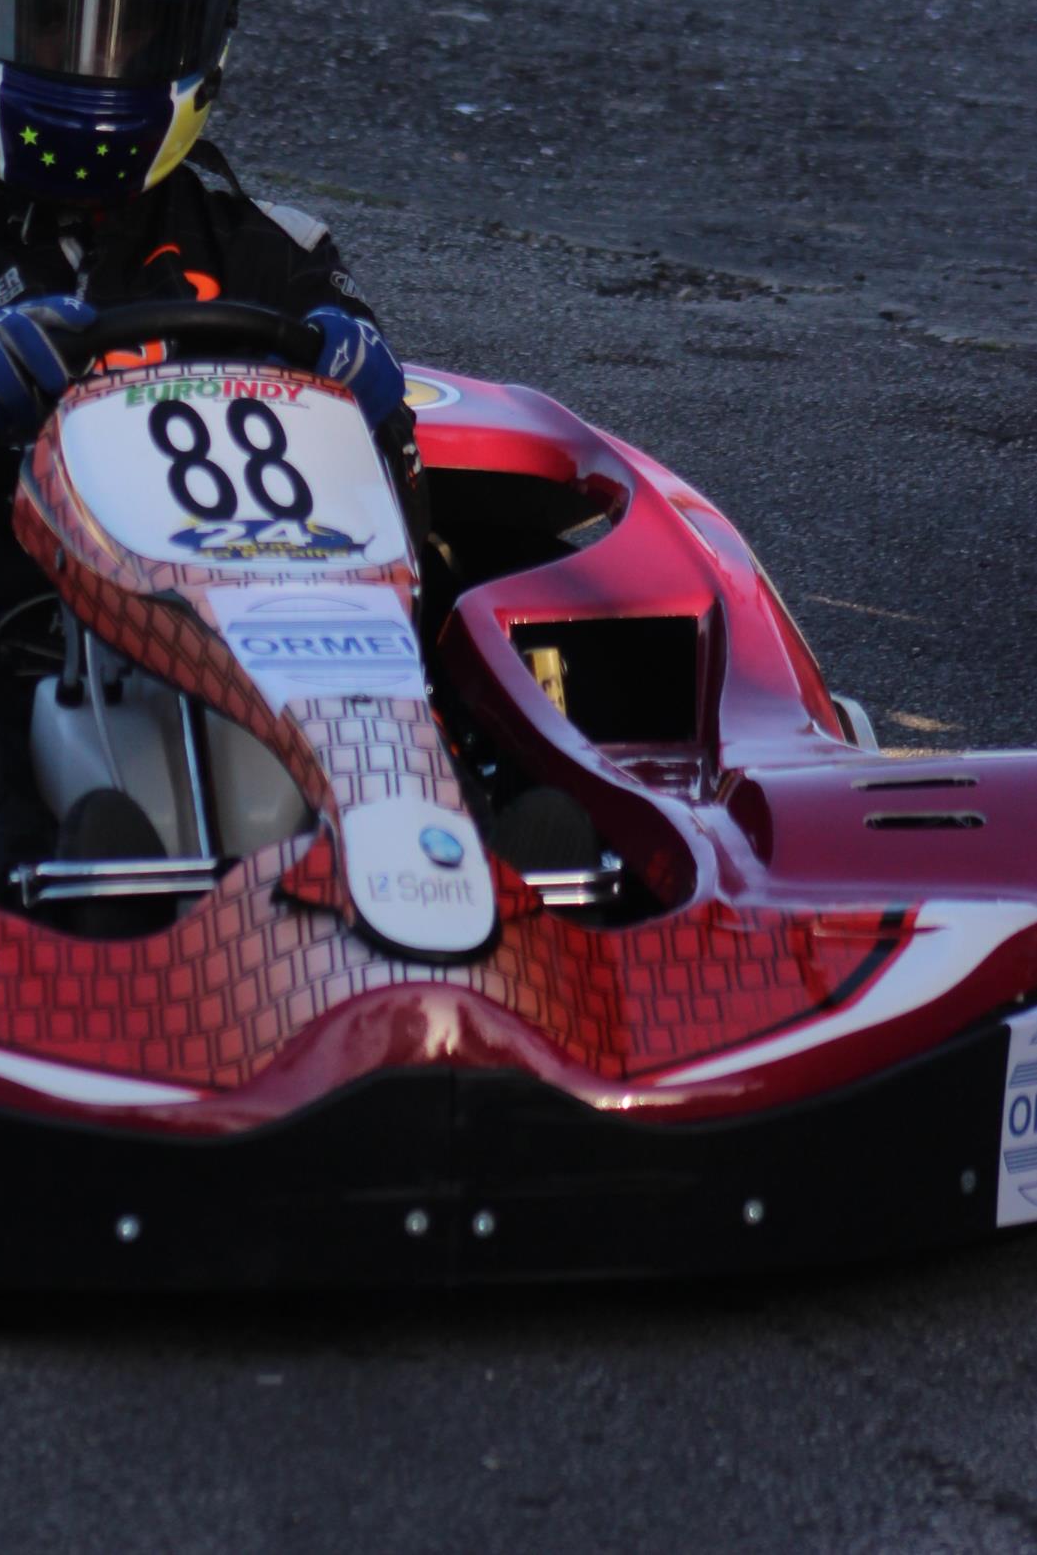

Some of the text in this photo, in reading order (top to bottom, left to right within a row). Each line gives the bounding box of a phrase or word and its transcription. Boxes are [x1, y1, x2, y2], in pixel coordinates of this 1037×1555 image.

[125, 378, 305, 409] EUROINDY
[147, 396, 314, 523] 88
[194, 520, 312, 549] 24
[240, 635, 415, 657] ORMEI
